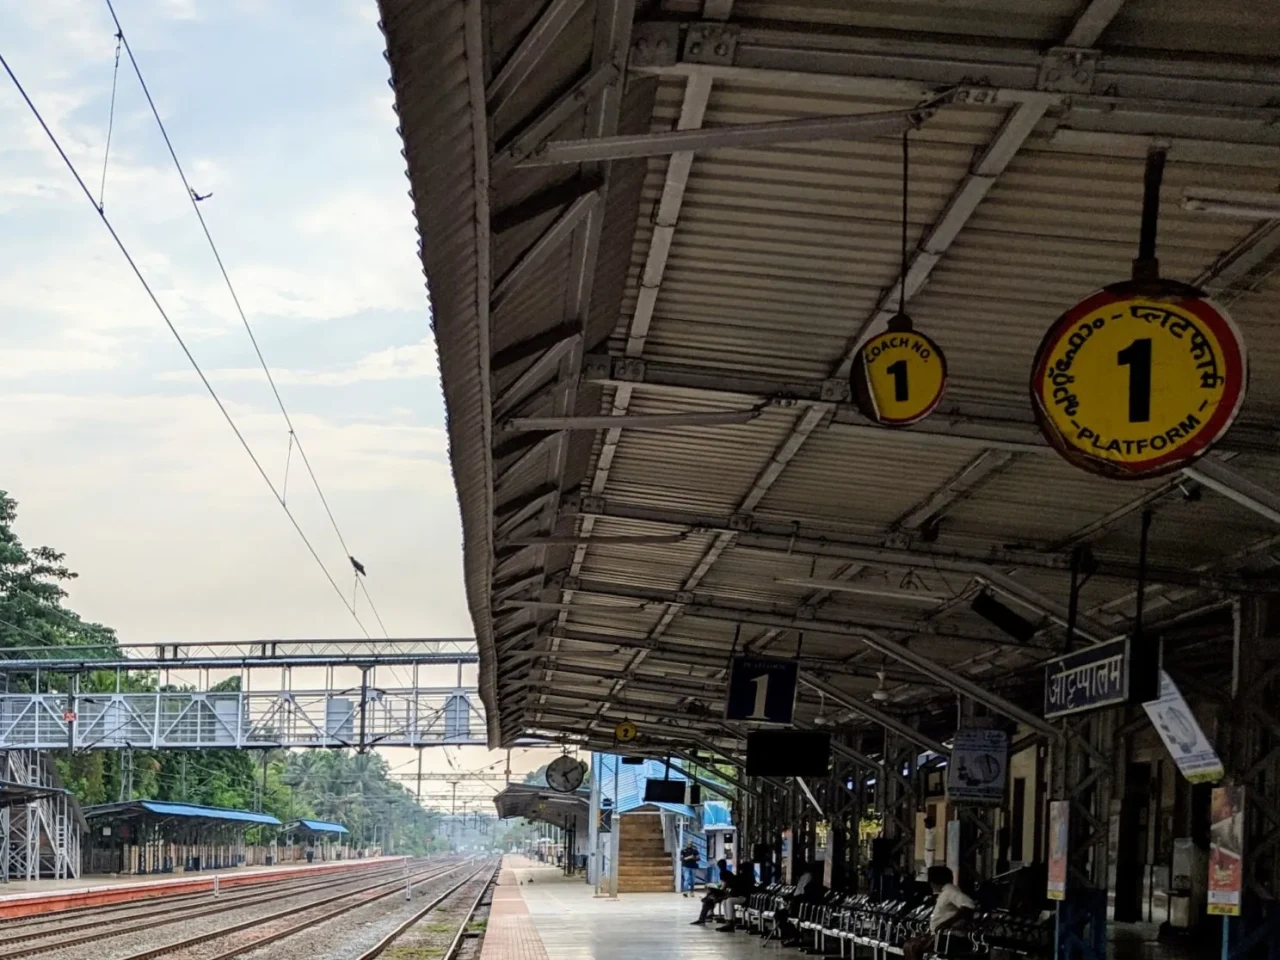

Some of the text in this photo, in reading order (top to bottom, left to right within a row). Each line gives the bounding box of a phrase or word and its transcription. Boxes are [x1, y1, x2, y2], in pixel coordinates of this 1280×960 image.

[865, 336, 910, 364] COACH
[886, 359, 909, 402] 1
[1117, 338, 1152, 423] 1
[1076, 413, 1202, 455] PLATFORM
[745, 673, 771, 720] 1
